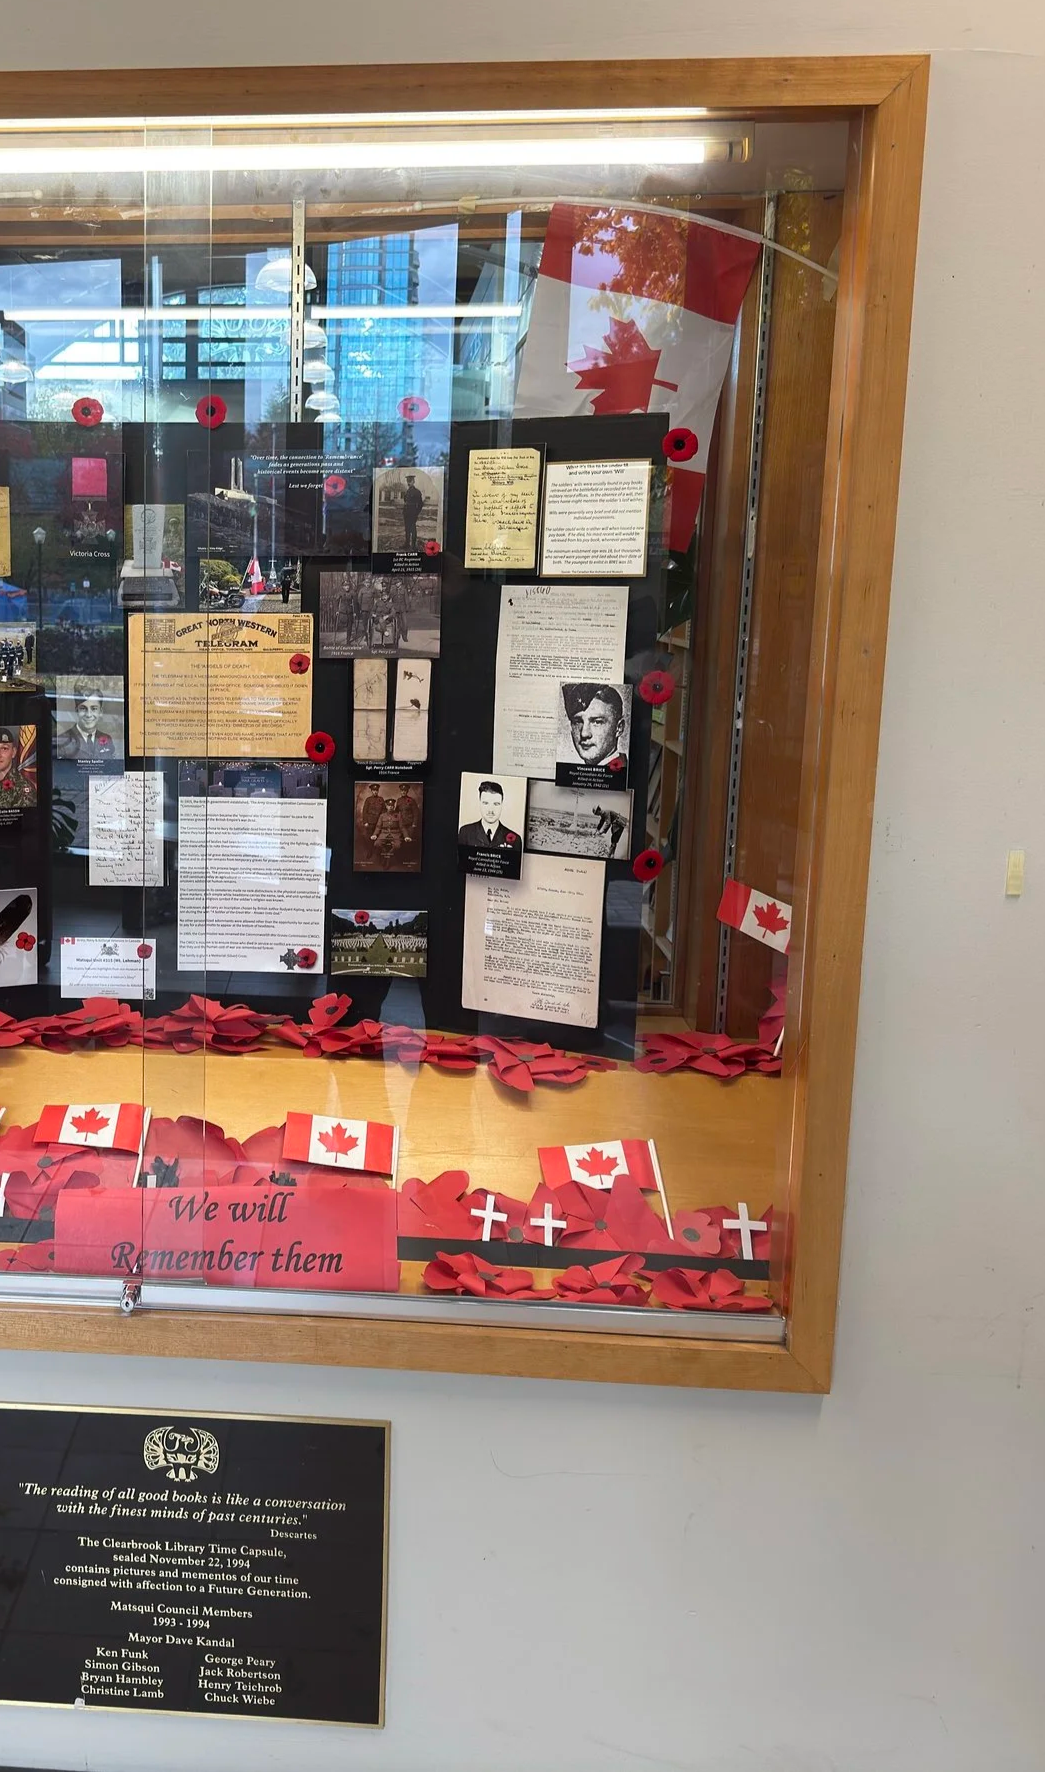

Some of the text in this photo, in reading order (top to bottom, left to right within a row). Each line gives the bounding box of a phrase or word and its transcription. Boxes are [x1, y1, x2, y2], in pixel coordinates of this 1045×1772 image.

[176, 622, 203, 637] GREAT
[238, 619, 277, 637] WESTERN
[169, 1191, 294, 1223] We will
[111, 1240, 343, 1273] Remember them
[18, 1482, 346, 1511] "The reading of all good books is like a conversation
[57, 1502, 308, 1525] with the finest minds of past centuries."
[270, 1529, 317, 1540] Descartes
[78, 1536, 286, 1558] The Clearbrook Library Time Capsule,
[113, 1553, 250, 1568] sealed November 22, 1994
[111, 1601, 253, 1618] Matsqui Council Members
[153, 1617, 176, 1627] 1993
[187, 1618, 210, 1629] 1994
[128, 1632, 235, 1648] Mayor Dave Kandal
[96, 1647, 148, 1659] Ken Funk
[85, 1659, 160, 1672] Simon Gibson
[205, 1654, 276, 1668] George Peary
[81, 1672, 163, 1686] Bryan Hambley
[199, 1666, 281, 1680] Jack Robertson
[81, 1685, 164, 1698] Christine Lamb
[198, 1679, 282, 1693] Henry Teichrob
[204, 1692, 275, 1706] Chuck Wiebe
